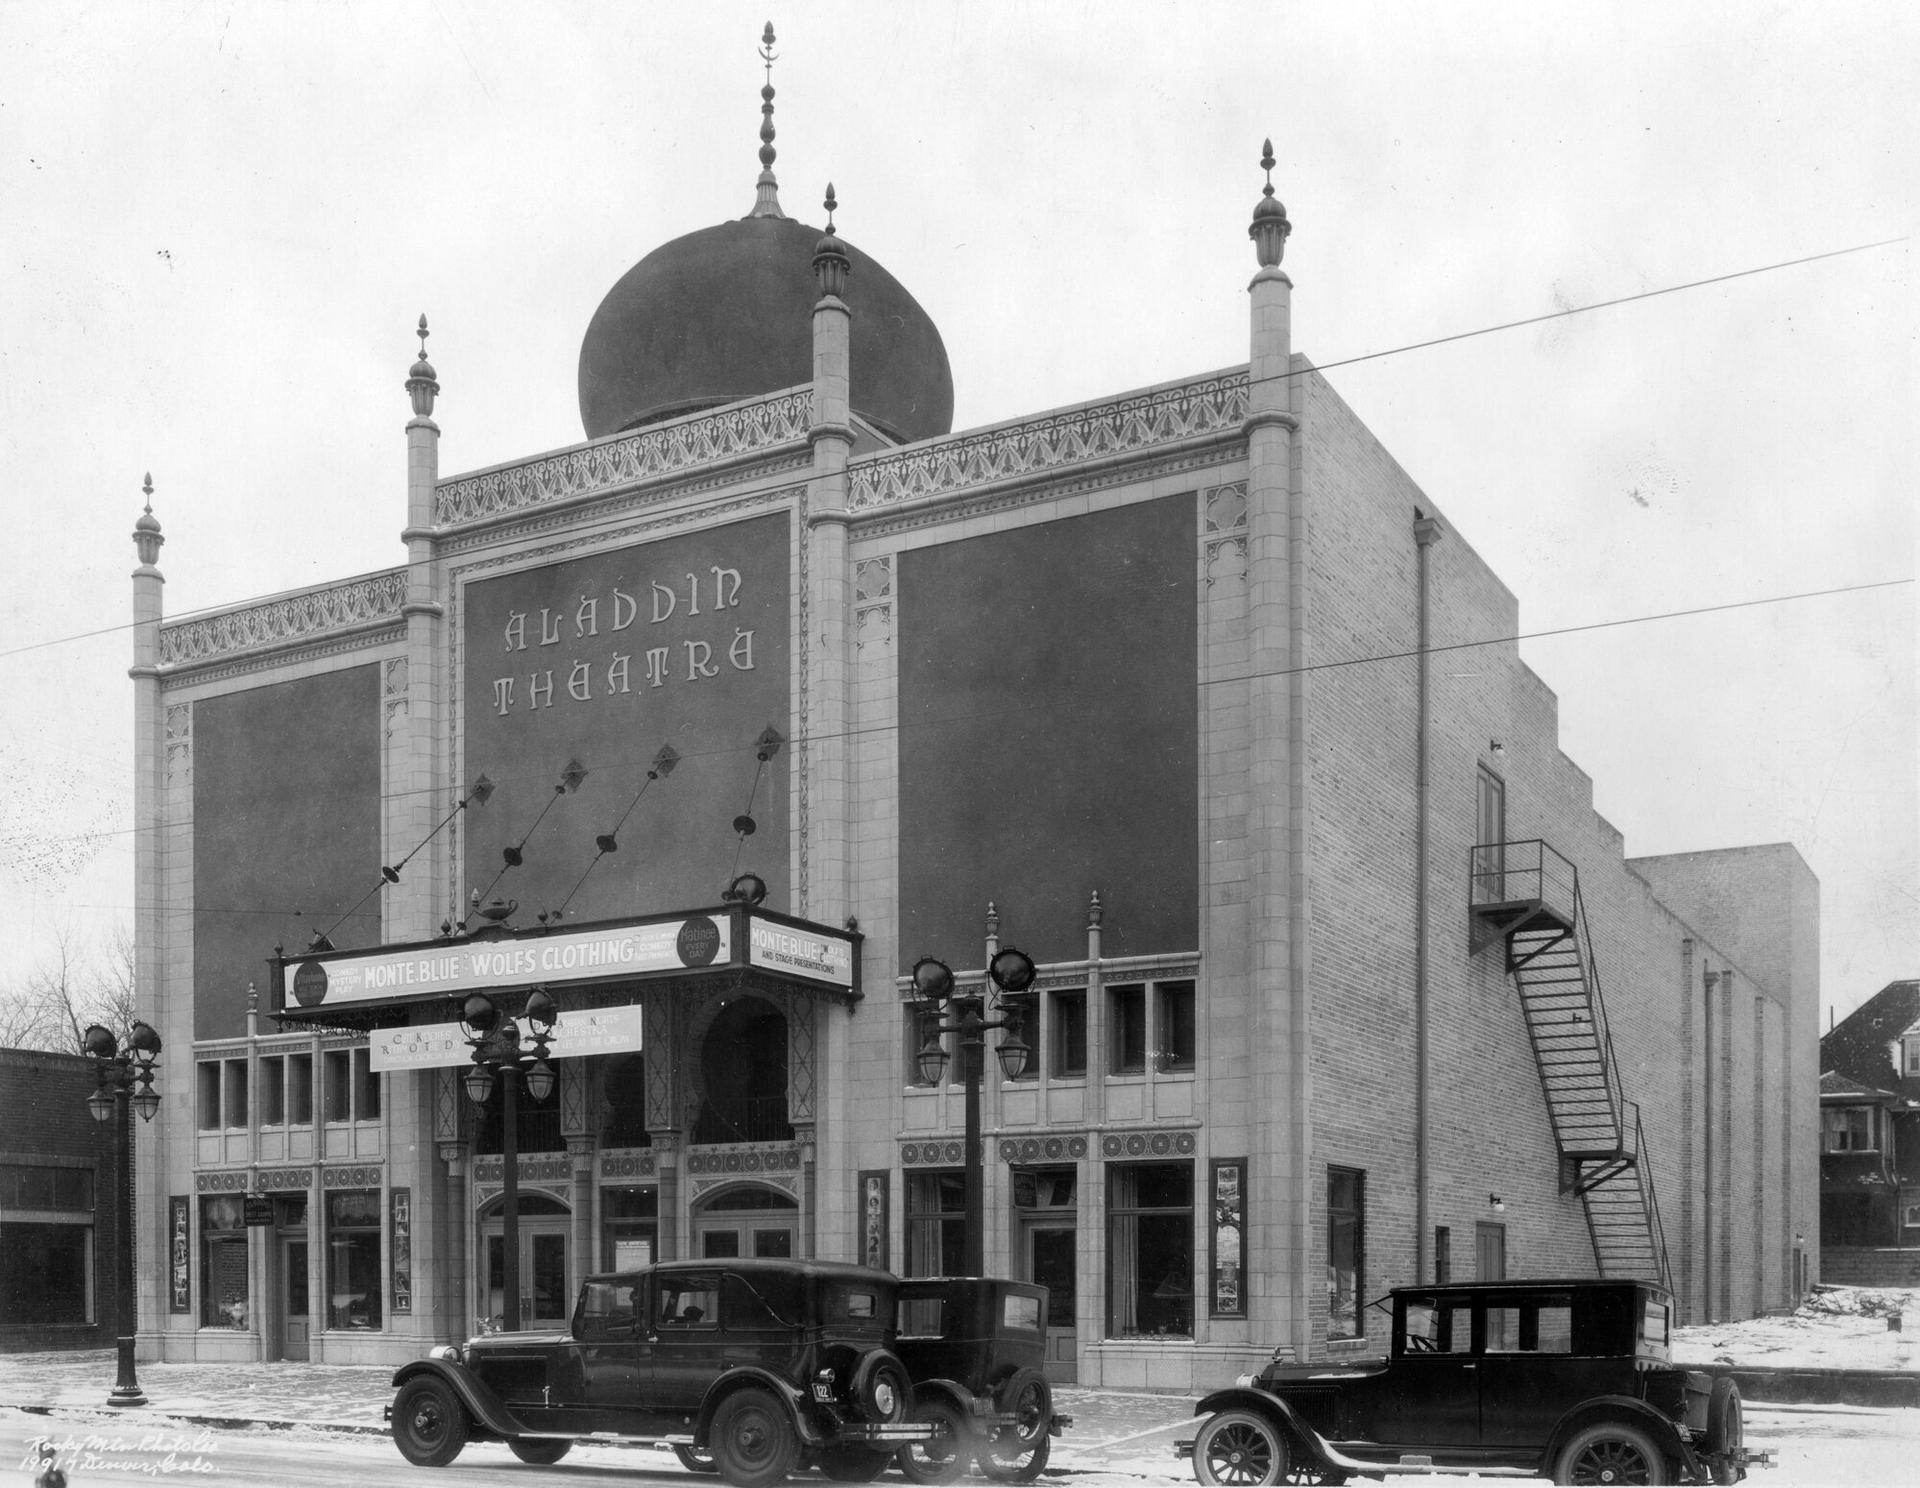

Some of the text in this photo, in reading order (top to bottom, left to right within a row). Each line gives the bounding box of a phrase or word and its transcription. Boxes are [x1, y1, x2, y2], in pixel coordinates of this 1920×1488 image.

[504, 566, 742, 652] ALADDIN
[492, 627, 756, 716] THEATRE
[689, 949, 706, 959] DAY
[752, 927, 817, 960] MONTE BLUE
[762, 950, 835, 975] AND STAGE PRESENTATIONS
